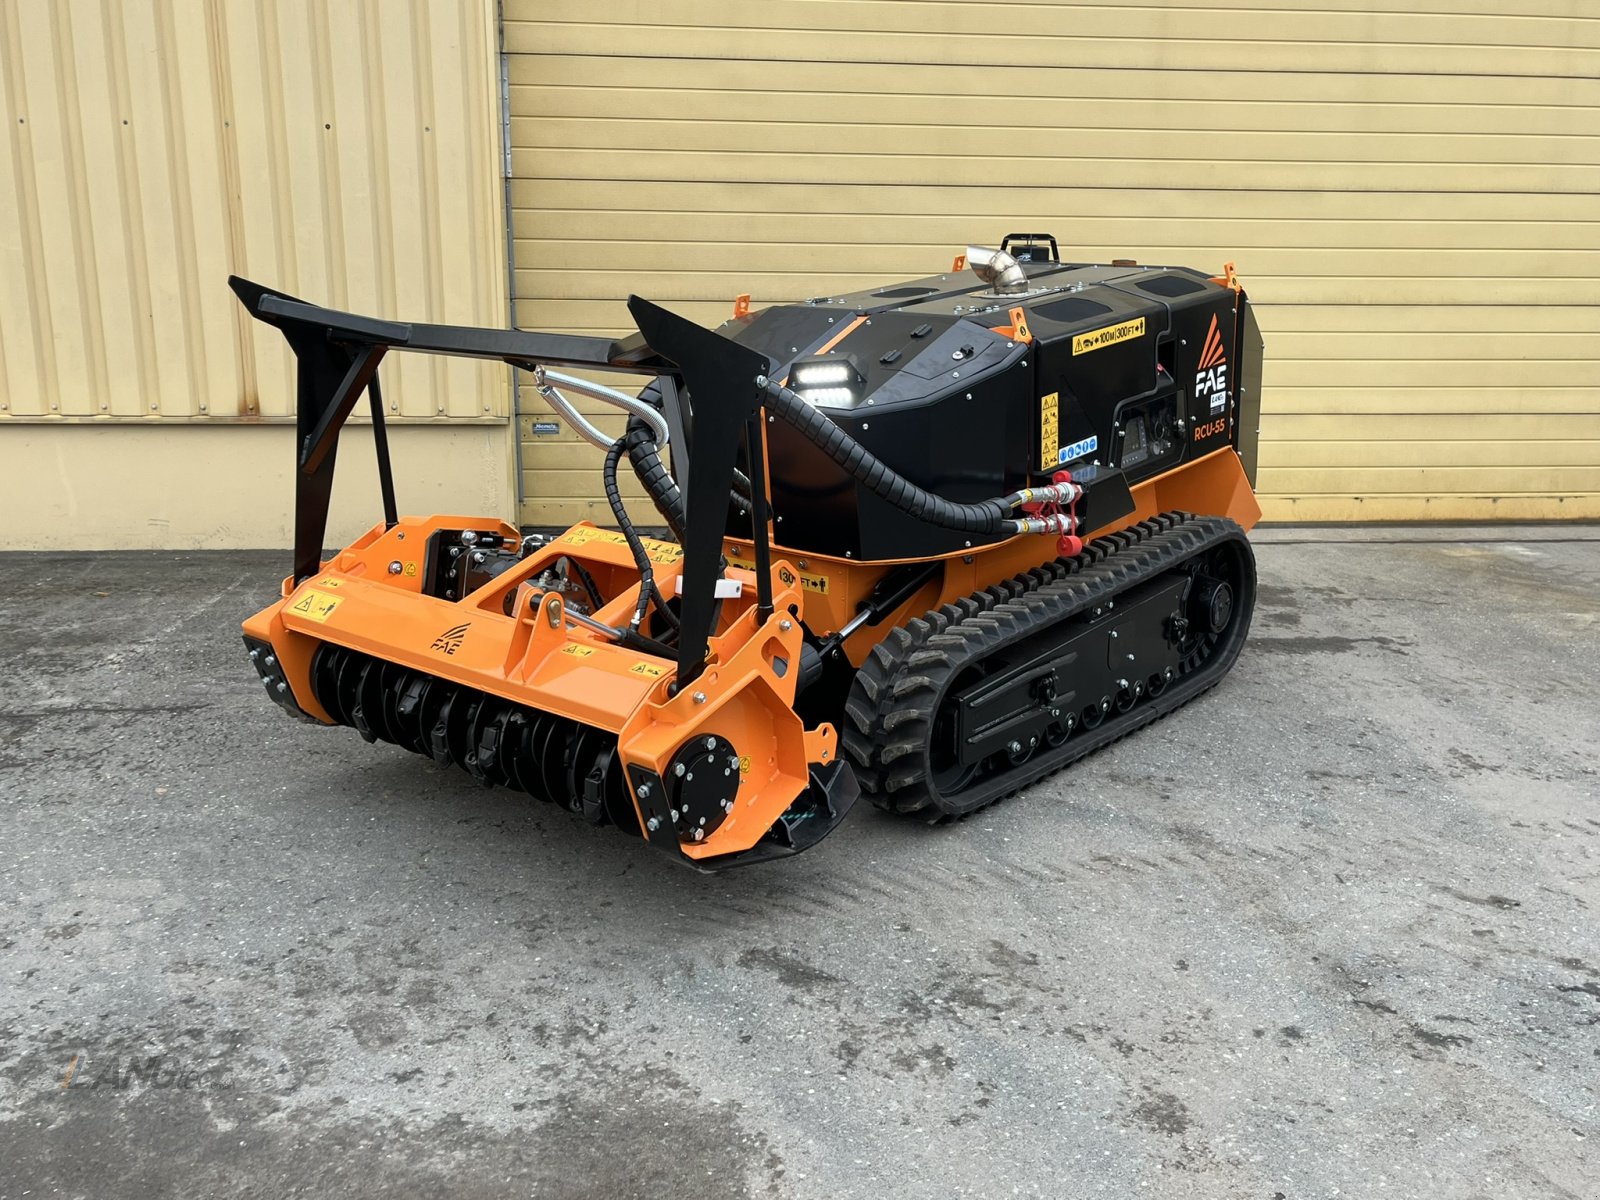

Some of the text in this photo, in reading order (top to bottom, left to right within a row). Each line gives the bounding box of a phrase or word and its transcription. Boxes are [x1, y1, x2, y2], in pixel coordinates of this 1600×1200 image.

[1195, 364, 1227, 397] FAE
[1194, 418, 1225, 441] RCU-55
[430, 638, 460, 655] FAE
